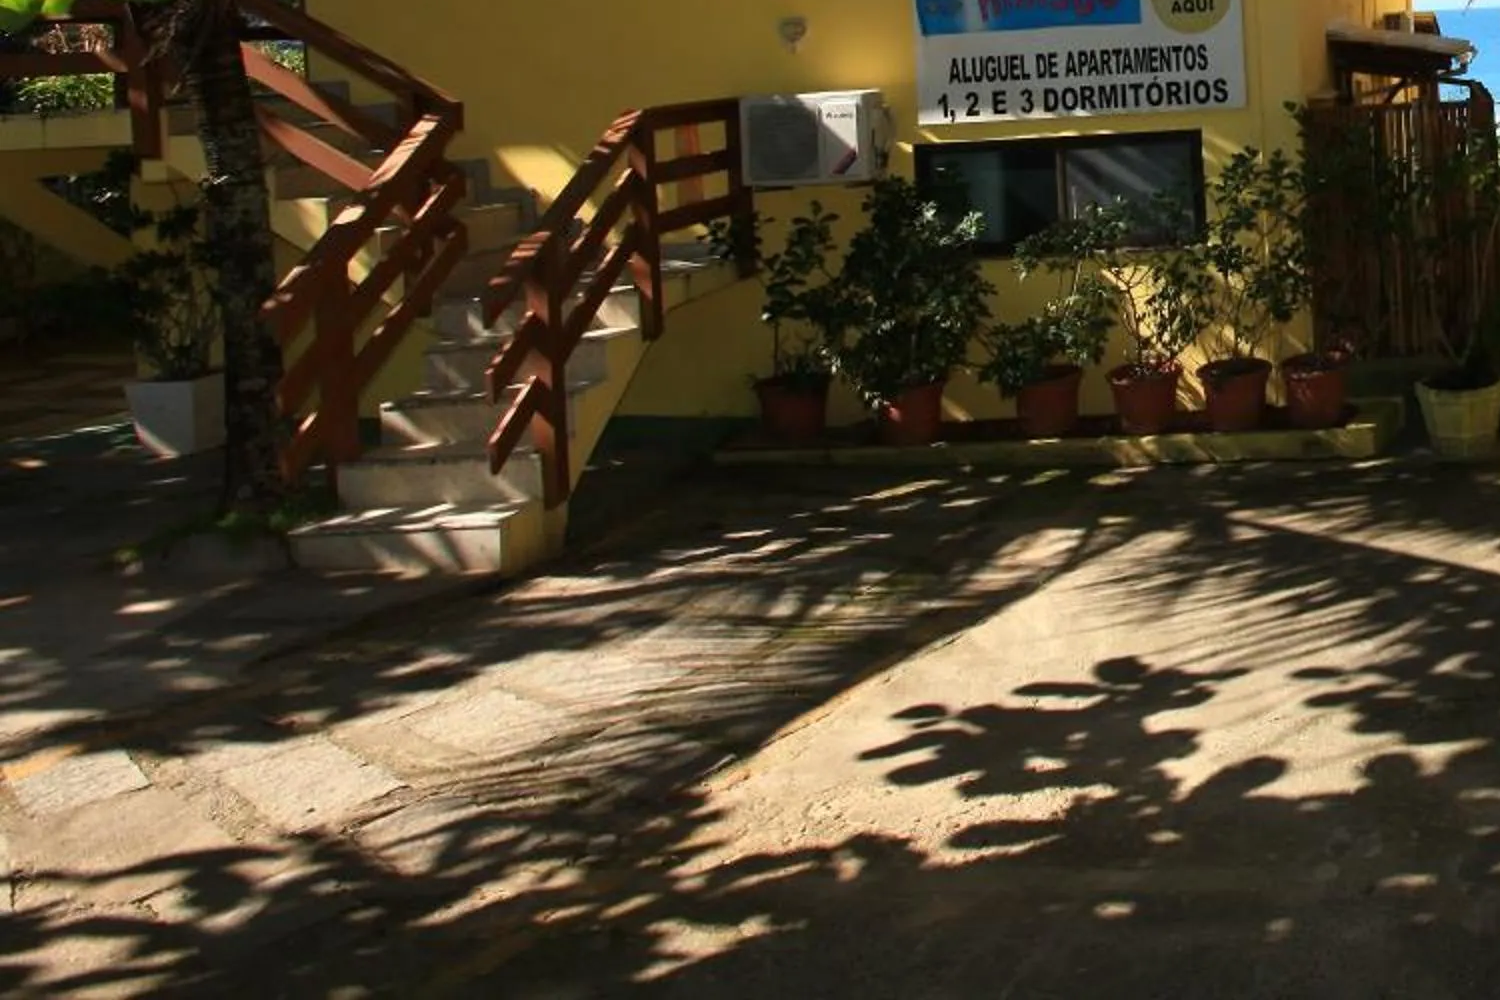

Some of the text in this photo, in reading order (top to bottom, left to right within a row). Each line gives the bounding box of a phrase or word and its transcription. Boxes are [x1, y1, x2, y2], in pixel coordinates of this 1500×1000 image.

[949, 44, 1208, 84] ALUGUEL DE APARTAMENTOS
[938, 77, 1228, 123] 1, 2 E 3 DORMITÓRIOS
